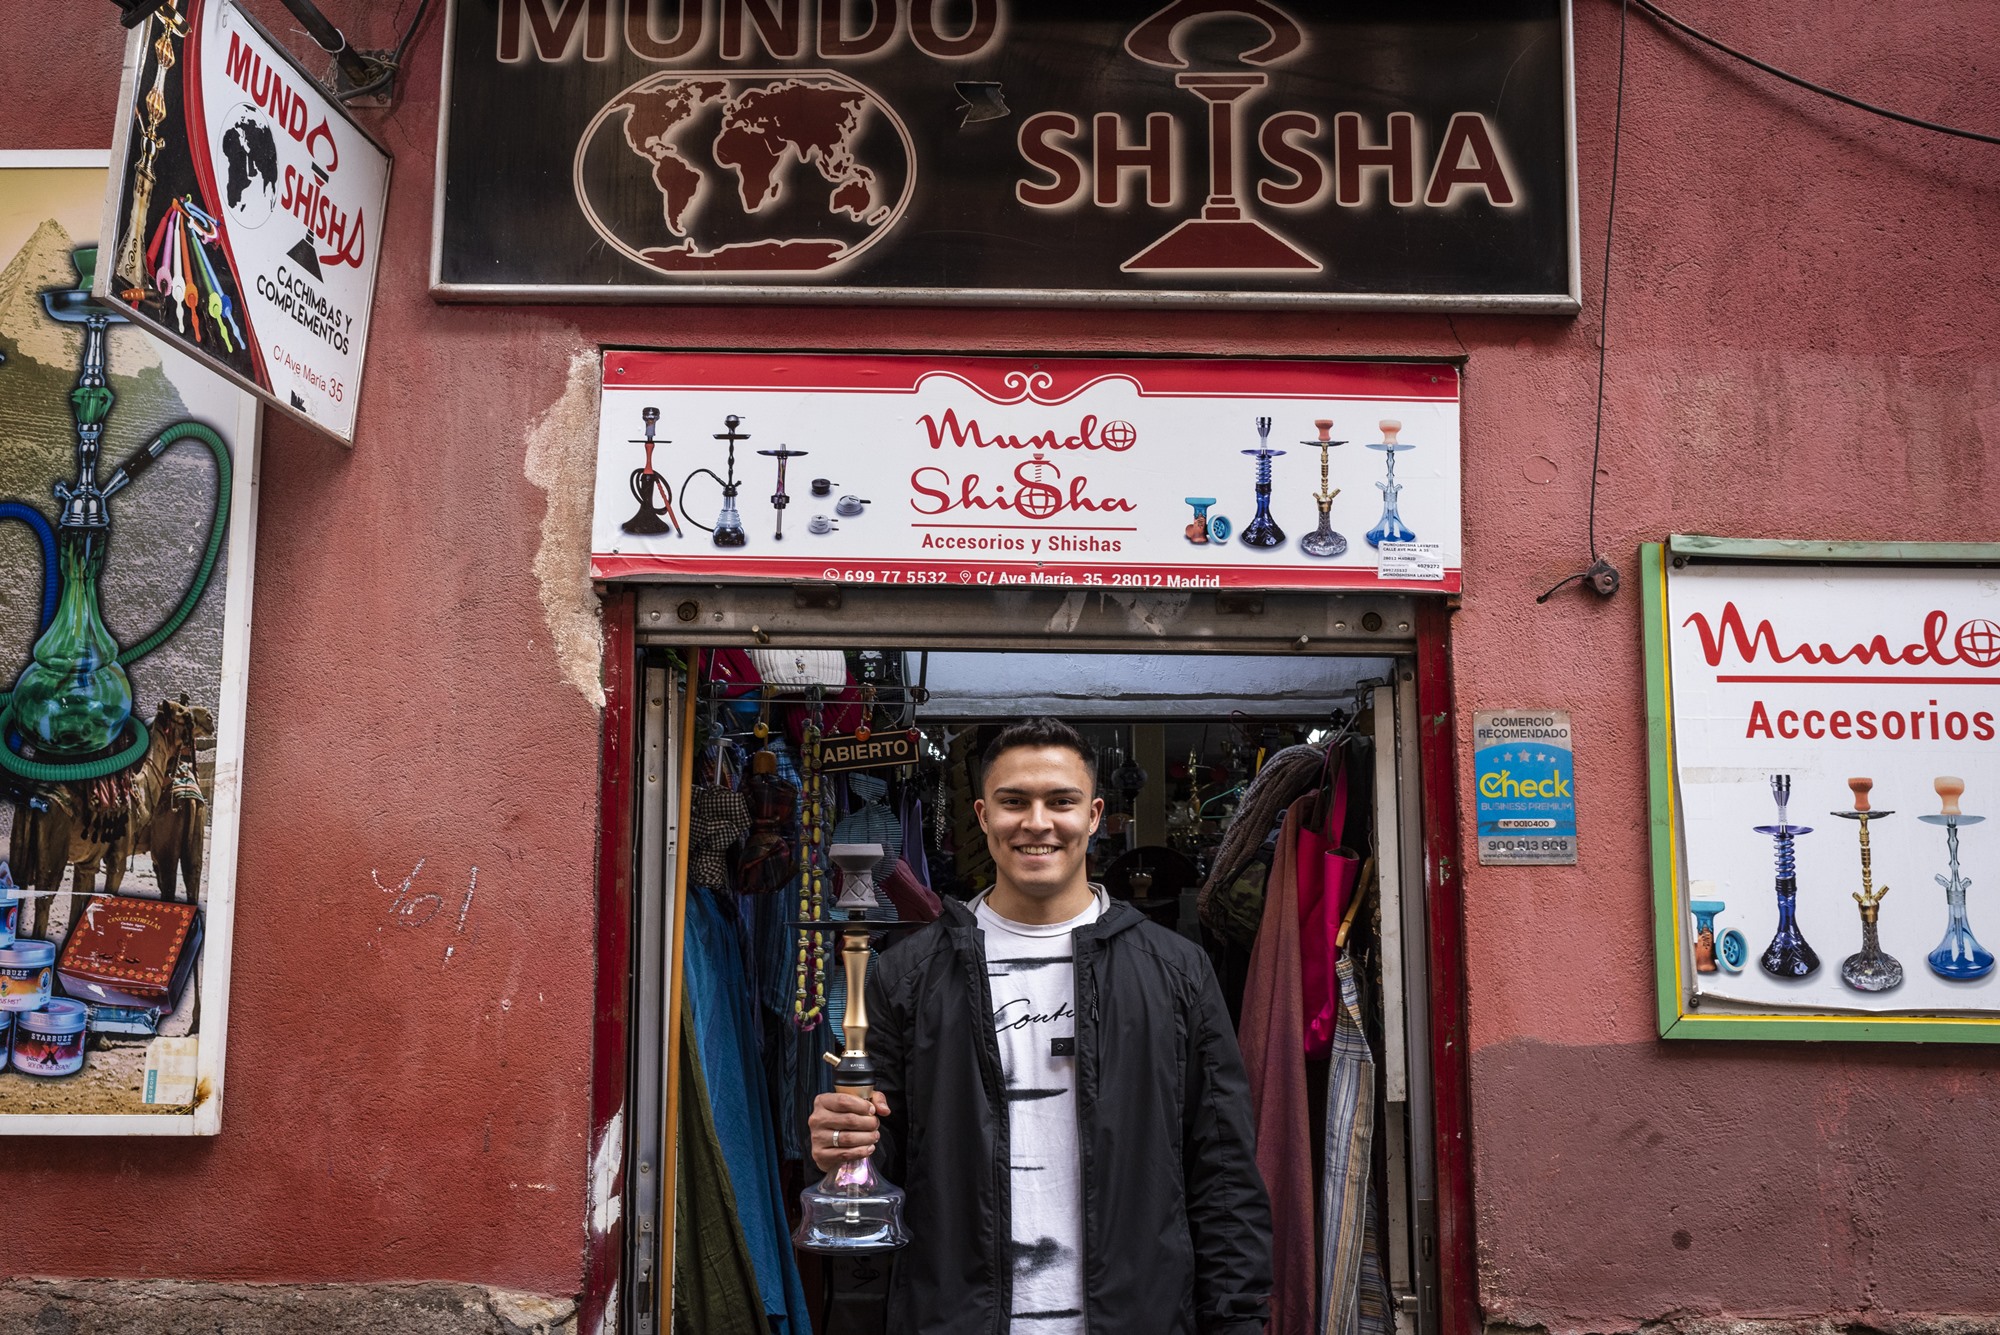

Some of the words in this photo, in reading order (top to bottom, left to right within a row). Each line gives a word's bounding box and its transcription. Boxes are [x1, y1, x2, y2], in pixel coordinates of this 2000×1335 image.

[496, 0, 1001, 62] MUNDO
[1016, 110, 1517, 208] SHISHA
[281, 164, 364, 268] SHISHA
[277, 265, 342, 328] CACHIMBAS
[344, 317, 353, 335] Y
[256, 274, 350, 356] COMPLEMENTOS
[273, 345, 284, 362] C/
[284, 353, 302, 375] Ave
[303, 364, 327, 392] María
[328, 377, 344, 402] 35
[915, 407, 1137, 452] Mundo
[921, 533, 1025, 550] Accesorios
[1031, 538, 1042, 554] y
[1048, 535, 1122, 552] Shishas
[844, 570, 875, 583] 699
[881, 571, 901, 583] 77
[906, 571, 947, 584] 5532
[998, 572, 1026, 585] Ave
[1112, 574, 1162, 587] 28012
[1167, 575, 1220, 588] Madrid
[1681, 601, 2000, 668] Mundo
[1491, 717, 1554, 727] COMERCIO
[1745, 699, 1996, 740] Accesorios
[1478, 729, 1568, 739] RECOMENDADO
[822, 739, 908, 764] ABIERTO
[1479, 769, 1571, 798] Check
[1481, 802, 1527, 811] BUSINESS
[1528, 802, 1572, 811] PREMIUM
[1513, 820, 1550, 828] 0010400
[1488, 840, 1514, 851] 900
[1517, 840, 1539, 851] 813
[1541, 840, 1568, 851] 808
[0, 969, 29, 977] RBUZZ
[31, 1032, 72, 1042] STARBUZZ
